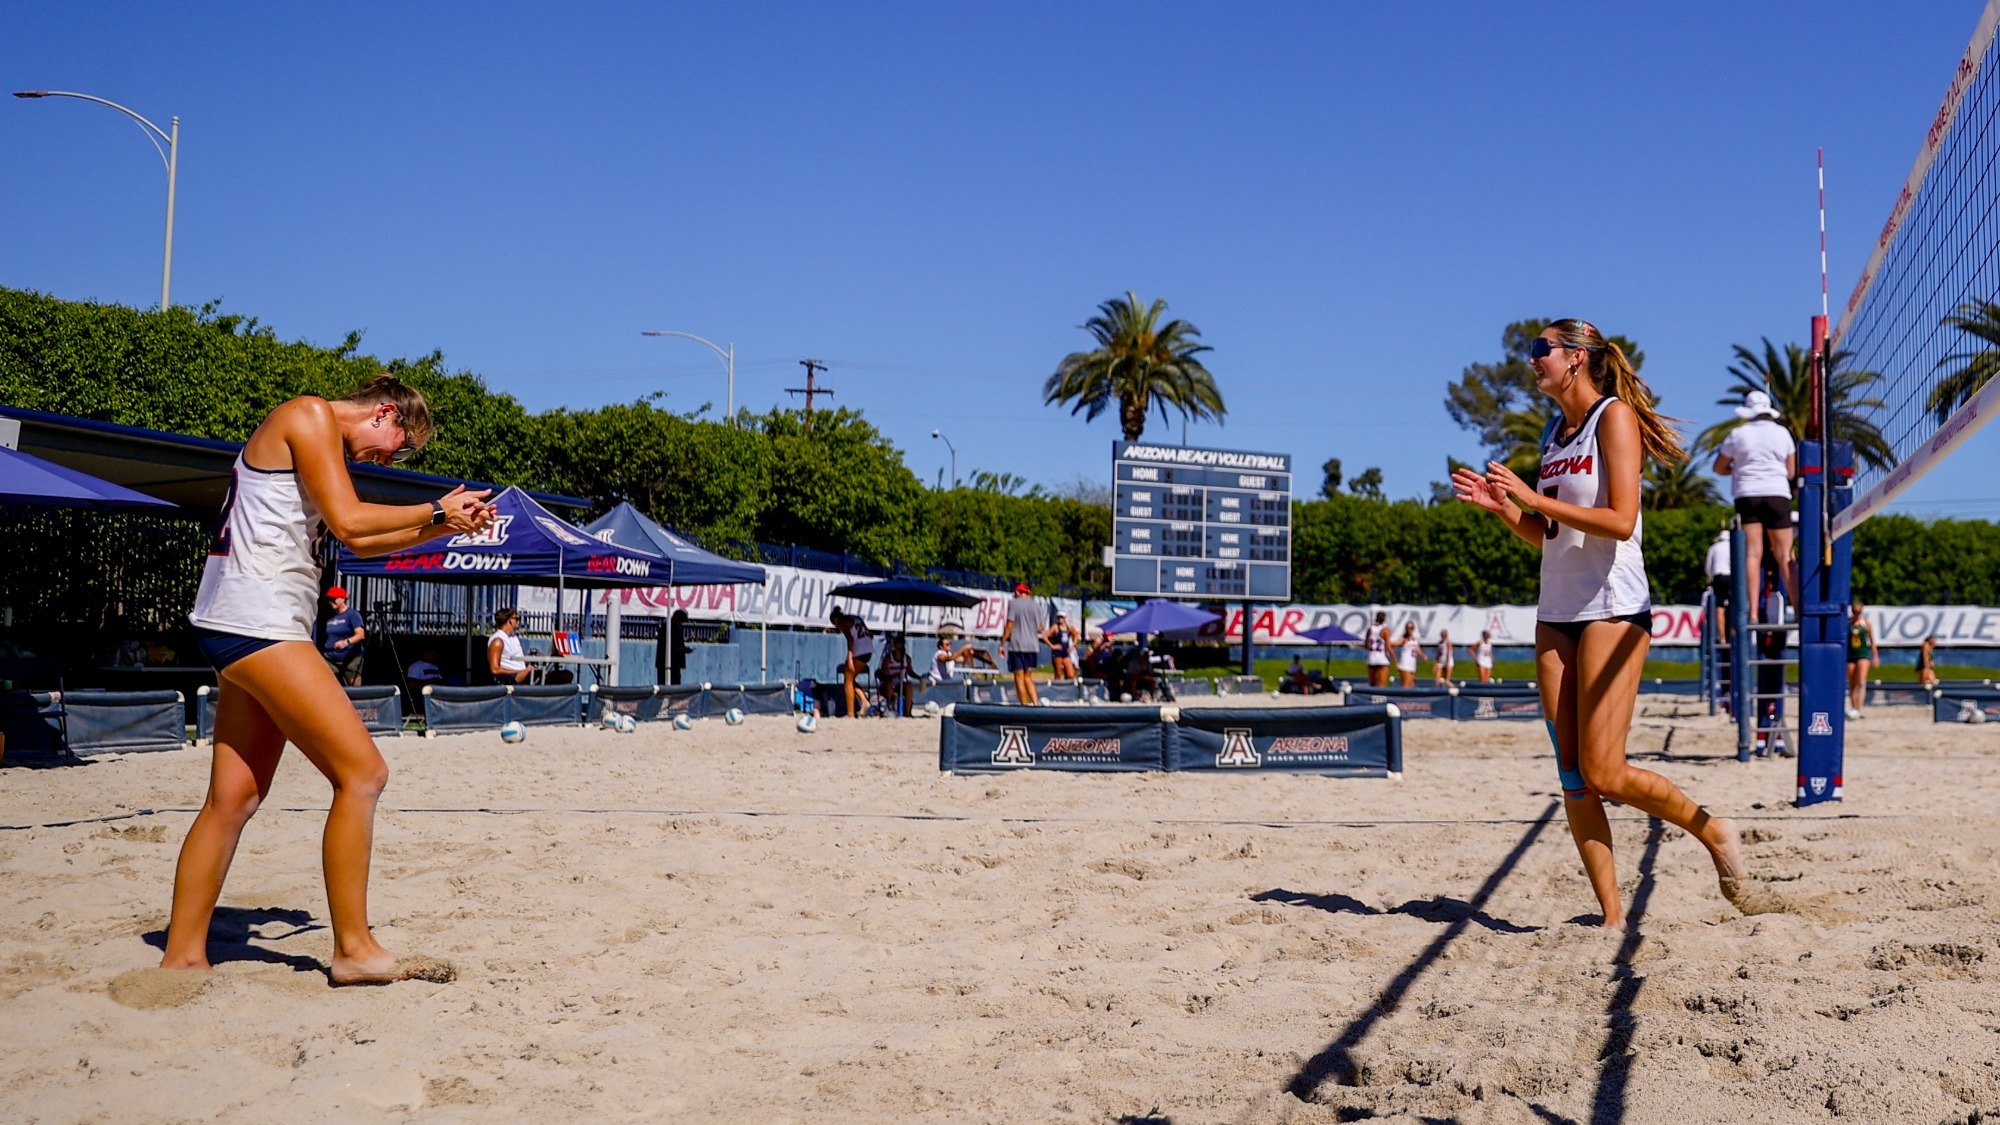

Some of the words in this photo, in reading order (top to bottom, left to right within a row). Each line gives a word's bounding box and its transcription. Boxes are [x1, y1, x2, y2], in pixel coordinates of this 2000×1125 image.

[1123, 445, 1178, 462] ARIZONA
[1177, 448, 1218, 466] BEACH
[1217, 451, 1286, 470] VOLLEYBALL
[1132, 467, 1159, 481] HOME
[1540, 455, 1593, 480] RIZONA
[1239, 475, 1266, 488] GUEST
[1132, 491, 1152, 503] HOME
[1221, 497, 1240, 508] HOME
[1130, 506, 1152, 518] GUEST
[1219, 511, 1241, 523] GUEST
[1131, 528, 1151, 539] HOME
[1220, 533, 1239, 544] HOME
[1129, 543, 1152, 554] GUEST
[1219, 547, 1240, 558] GUEST
[385, 553, 445, 571] BEAR
[443, 552, 512, 571] DOWN
[587, 555, 618, 574] BEAR
[616, 556, 651, 577] DOWN
[1176, 567, 1195, 578] HOME
[1174, 581, 1196, 592] GUEST
[737, 573, 816, 618] BEACH
[976, 597, 1006, 629] BEA
[1878, 610, 2000, 639] VOLLE
[1808, 712, 1833, 735] A
[991, 725, 1036, 766] A
[1042, 737, 1121, 755] ARIZONA
[1216, 728, 1262, 768] A
[1267, 736, 1349, 754] ARIZONA
[1298, 754, 1349, 762] VOLLEYBALL
